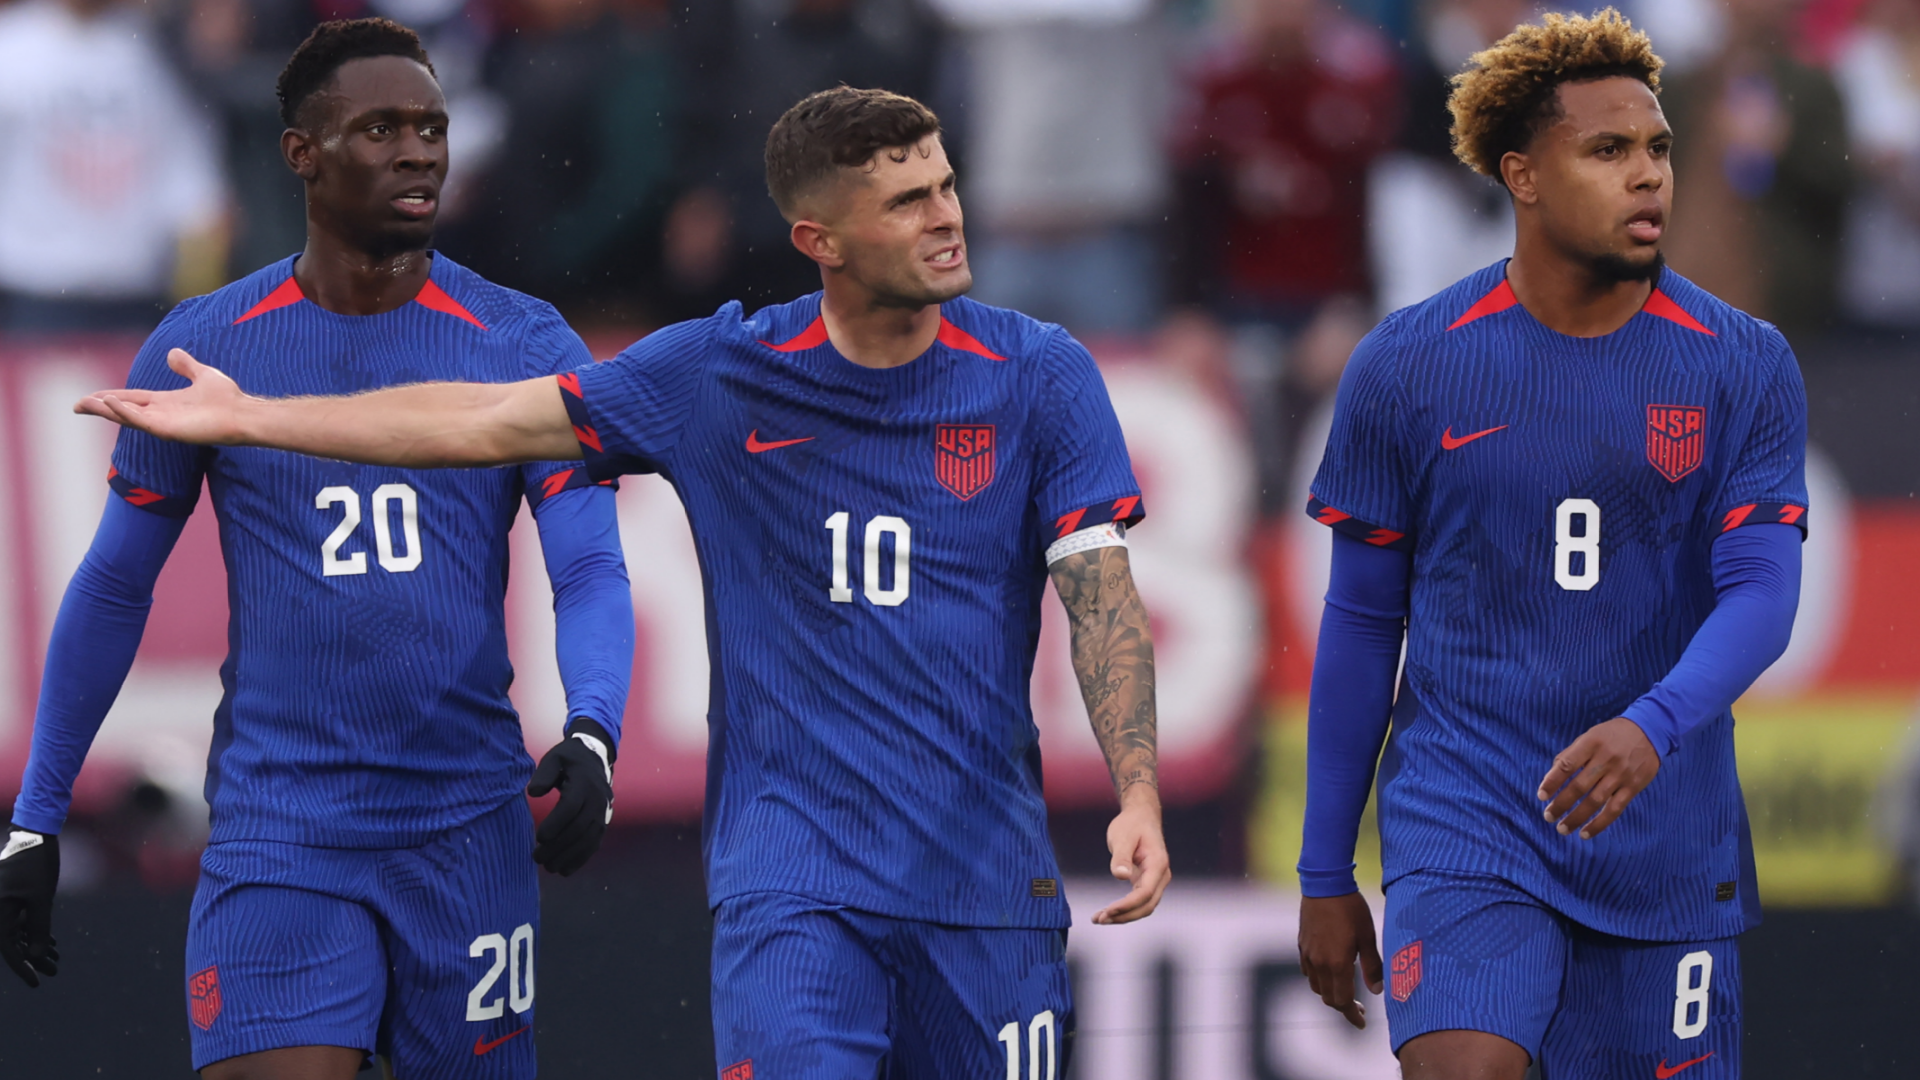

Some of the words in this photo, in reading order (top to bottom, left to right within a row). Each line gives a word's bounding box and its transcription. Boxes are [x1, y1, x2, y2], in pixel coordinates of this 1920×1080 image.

[940, 428, 990, 458] USA
[1652, 409, 1700, 438] USA
[315, 483, 423, 577] 20
[824, 511, 912, 607] 10
[1554, 498, 1601, 591] 8
[190, 970, 216, 997] USA
[465, 922, 535, 1022] 20
[1392, 945, 1419, 972] USA
[1672, 950, 1713, 1040] 8
[997, 1009, 1055, 1080] 10
